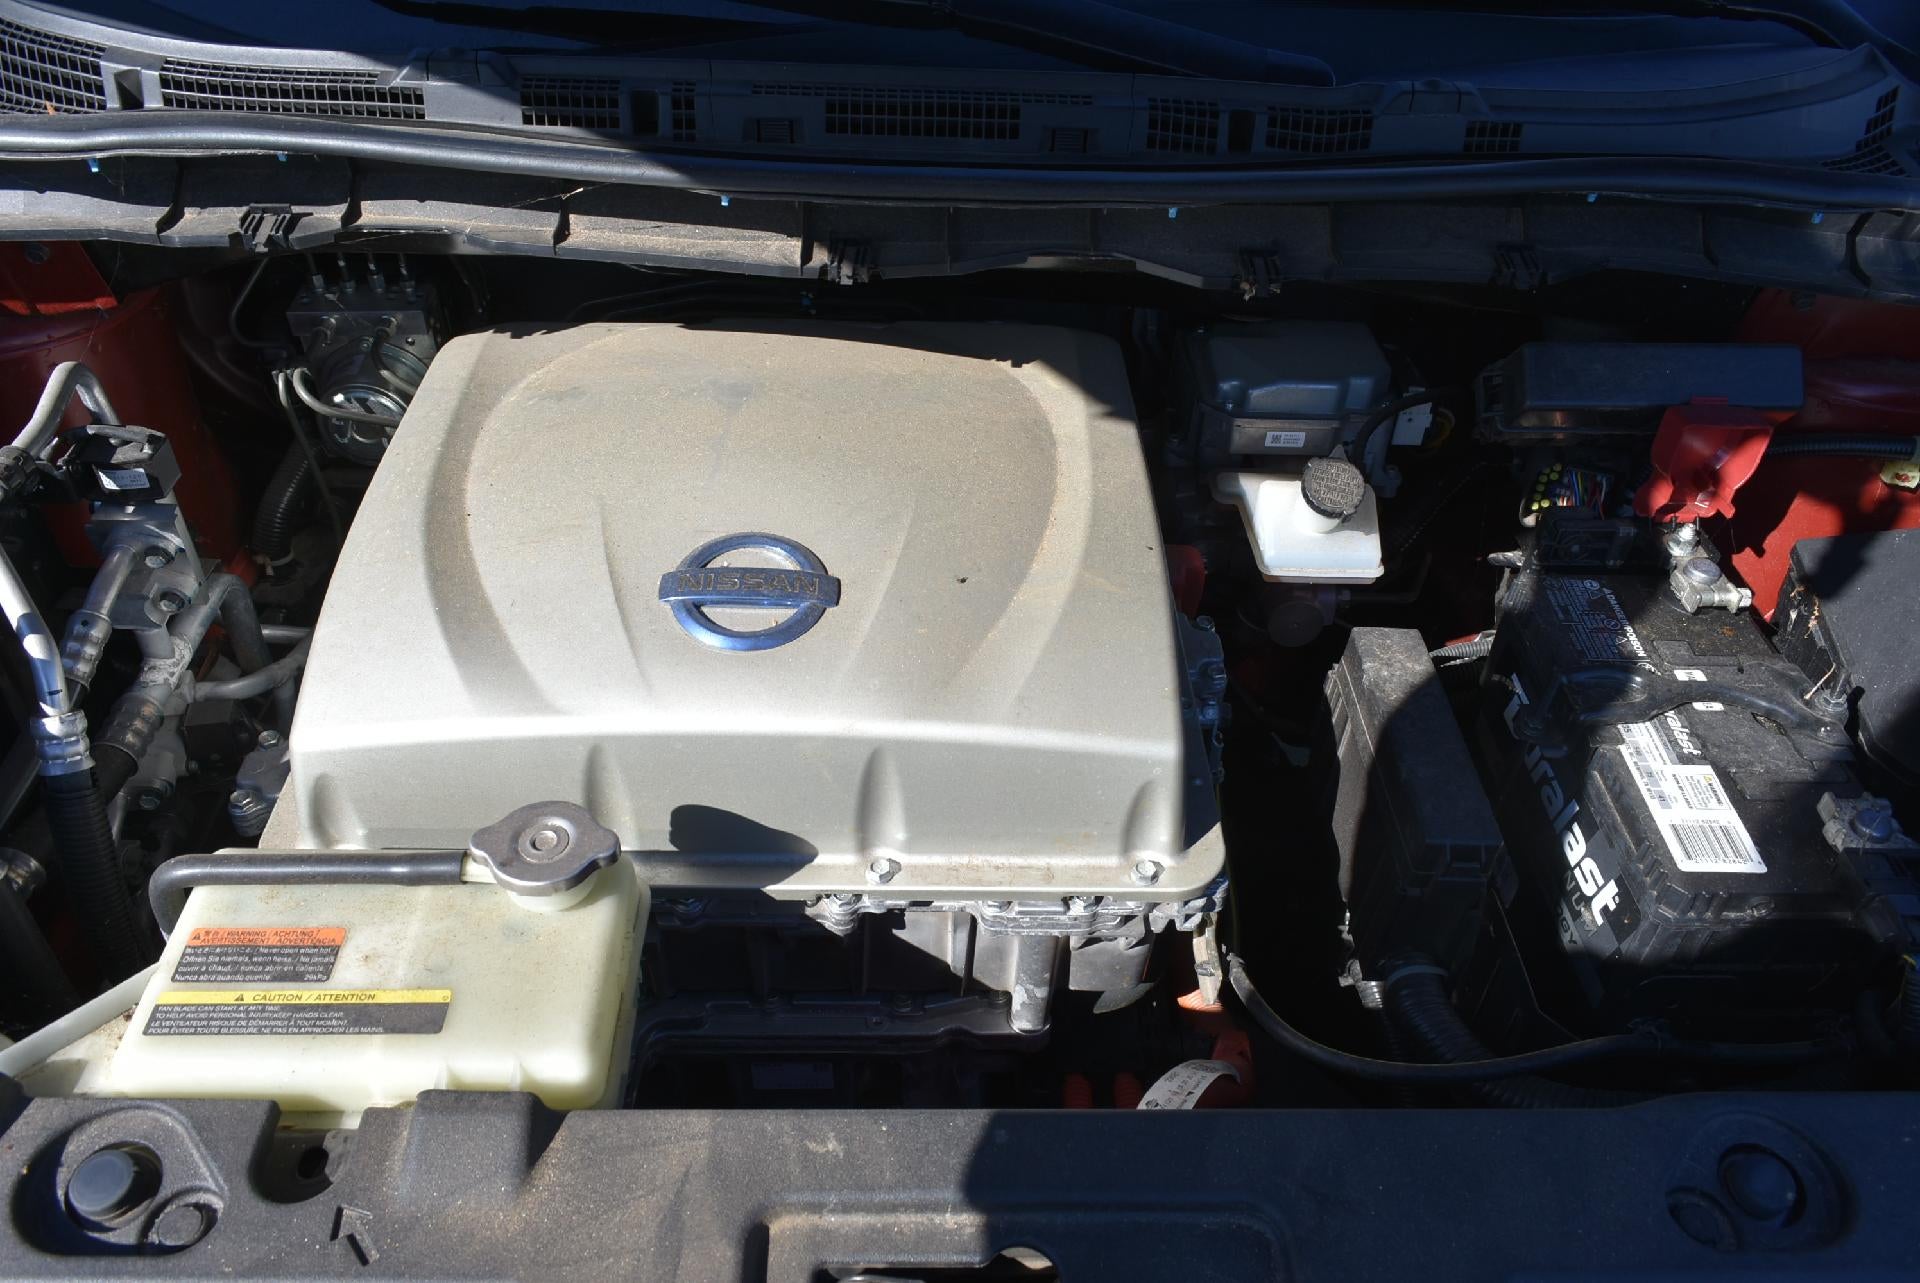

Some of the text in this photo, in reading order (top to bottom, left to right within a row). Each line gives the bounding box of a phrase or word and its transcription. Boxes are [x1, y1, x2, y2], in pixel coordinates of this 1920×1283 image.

[677, 572, 819, 595] NISSAN
[1664, 711, 1701, 755] ralast
[227, 930, 267, 938] WARNING
[252, 993, 304, 1002] CAUTION
[313, 993, 377, 1001] ATTENTION
